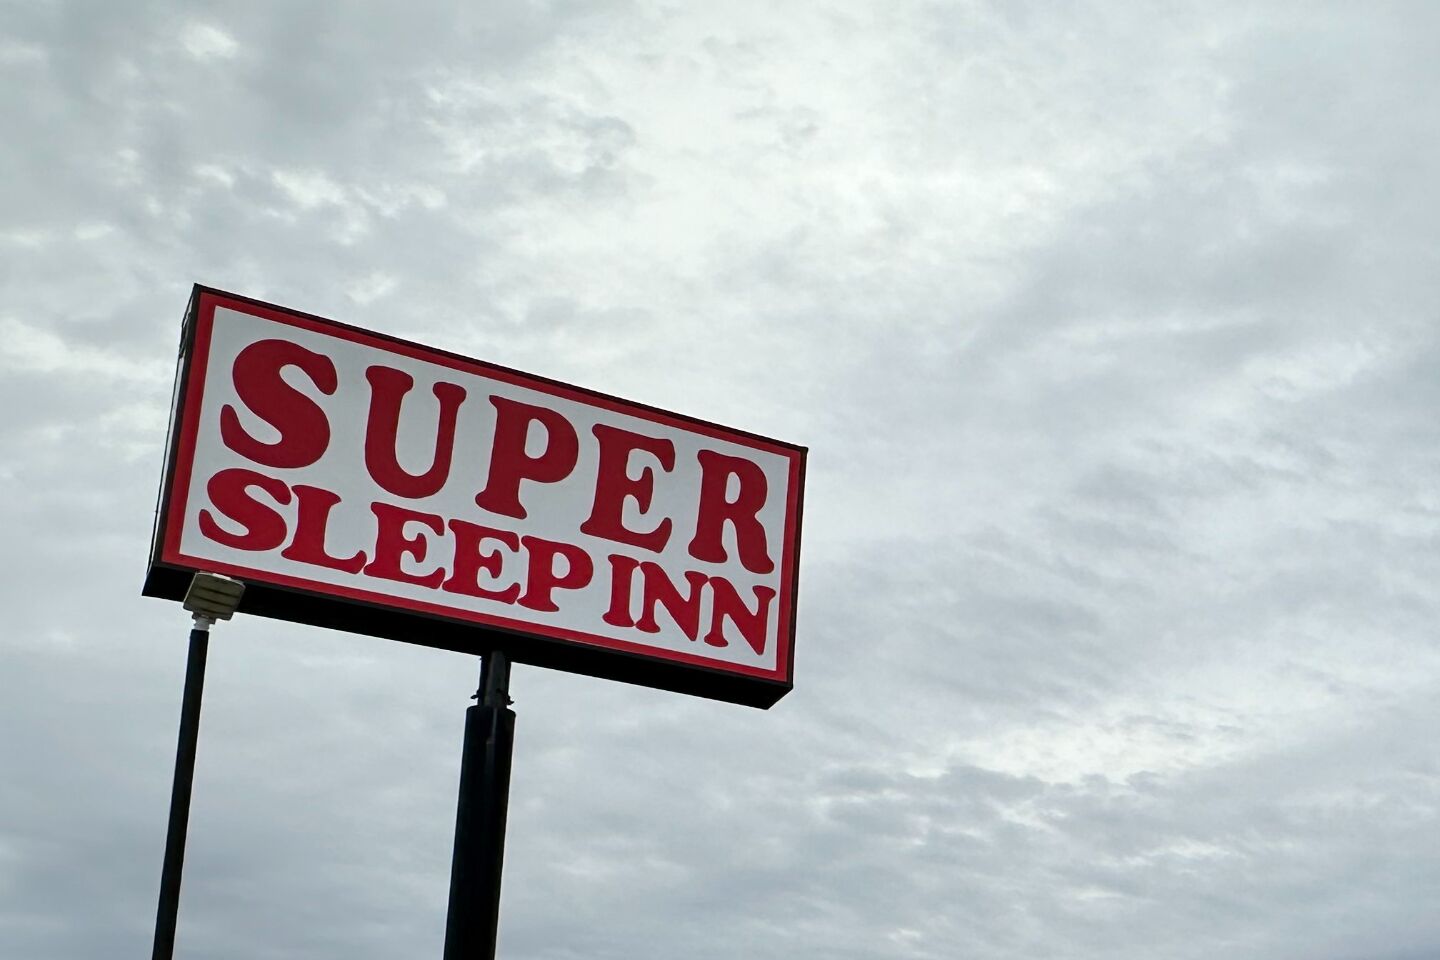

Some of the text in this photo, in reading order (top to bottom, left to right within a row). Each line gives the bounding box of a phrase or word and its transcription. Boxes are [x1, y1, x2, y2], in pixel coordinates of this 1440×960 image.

[198, 468, 777, 656] SLEEP INN
[220, 338, 774, 574] SUPER
